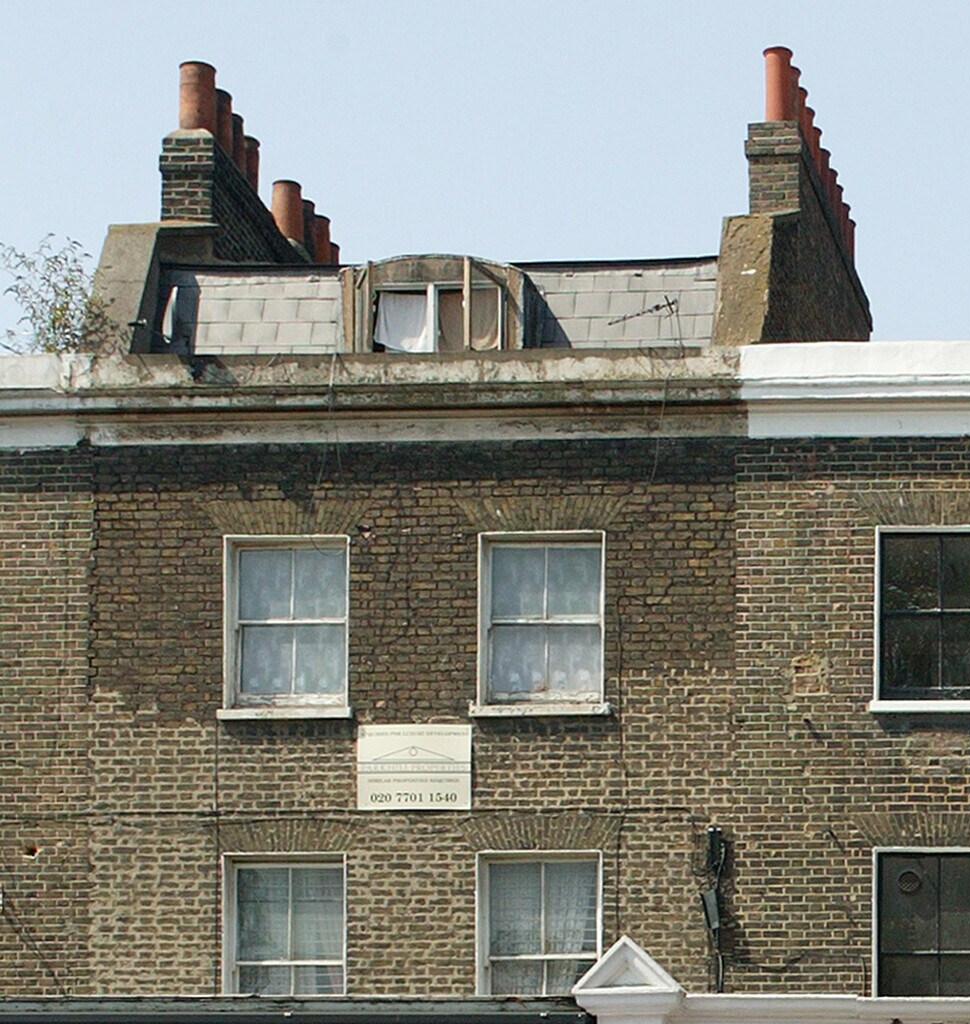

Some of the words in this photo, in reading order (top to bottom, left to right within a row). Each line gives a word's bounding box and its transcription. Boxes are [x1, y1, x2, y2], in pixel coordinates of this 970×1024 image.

[370, 793, 392, 803] 020
[396, 793, 423, 803] 7701
[429, 793, 458, 803] 1540
